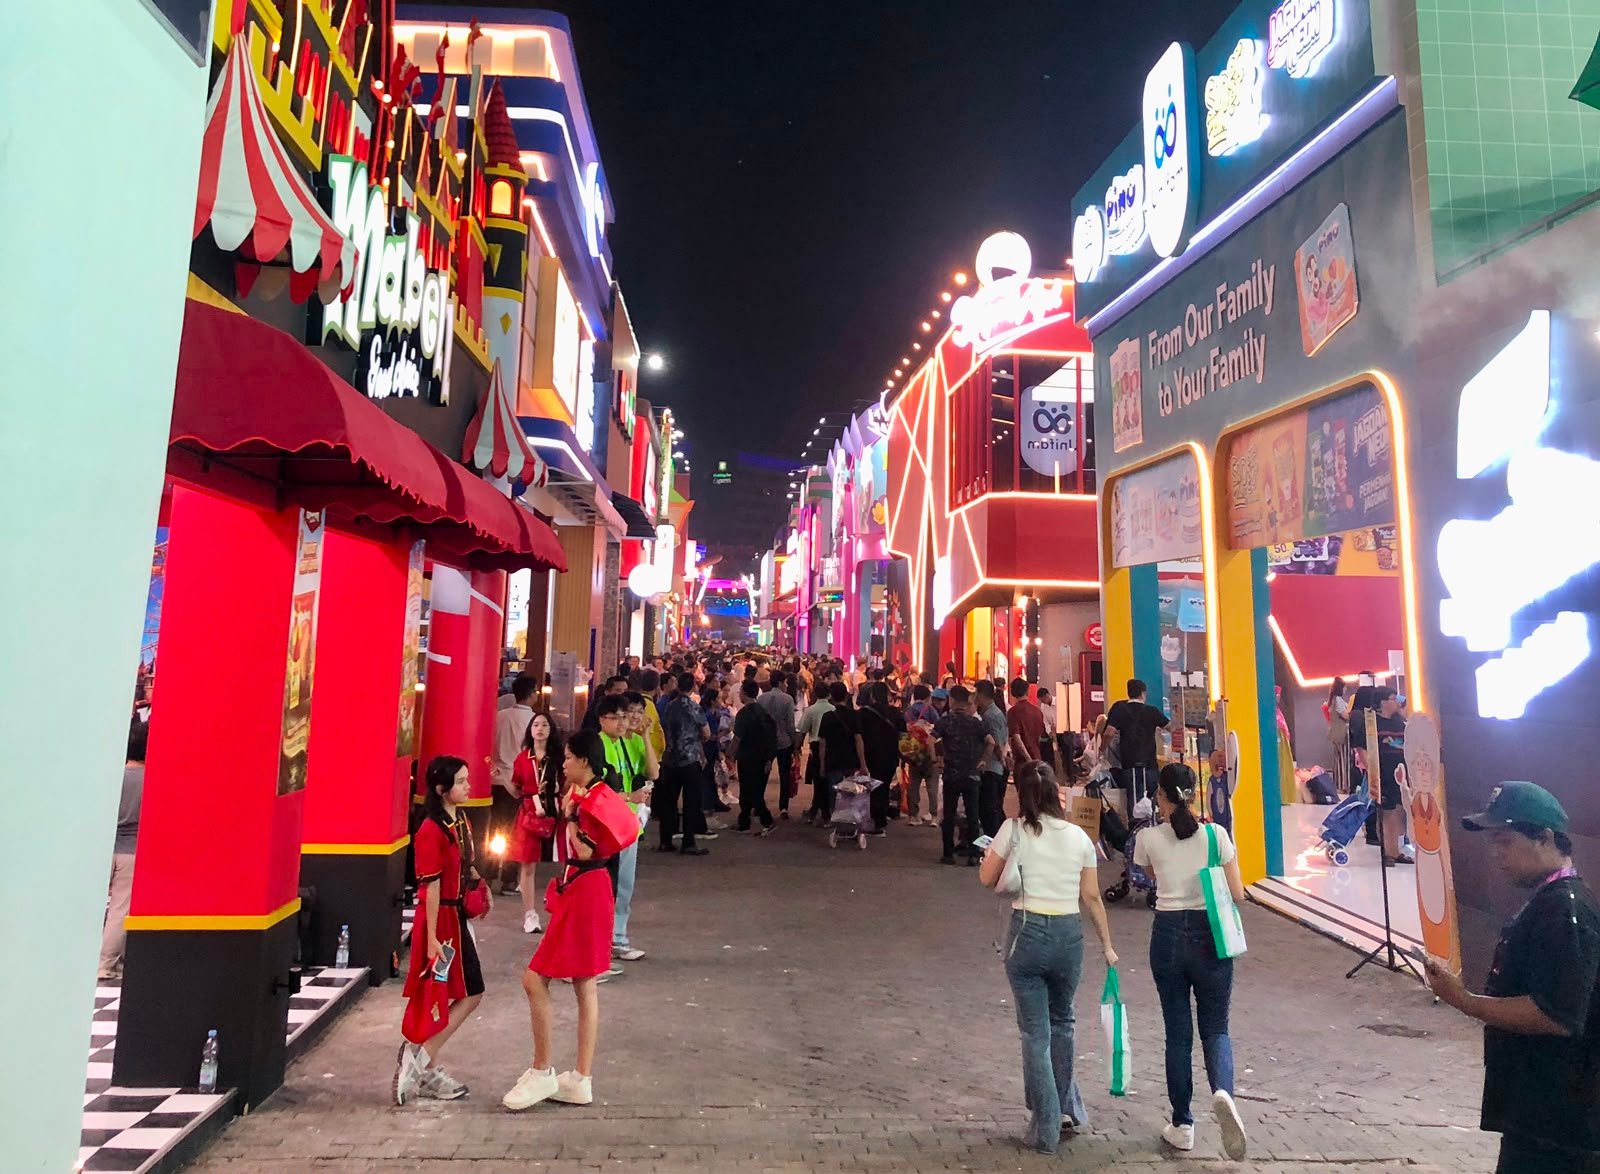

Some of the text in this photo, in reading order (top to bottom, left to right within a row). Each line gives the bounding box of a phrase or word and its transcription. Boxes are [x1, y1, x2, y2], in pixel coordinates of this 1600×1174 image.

[1147, 258, 1276, 369] From Our Family
[1158, 327, 1267, 417] to Your Family
